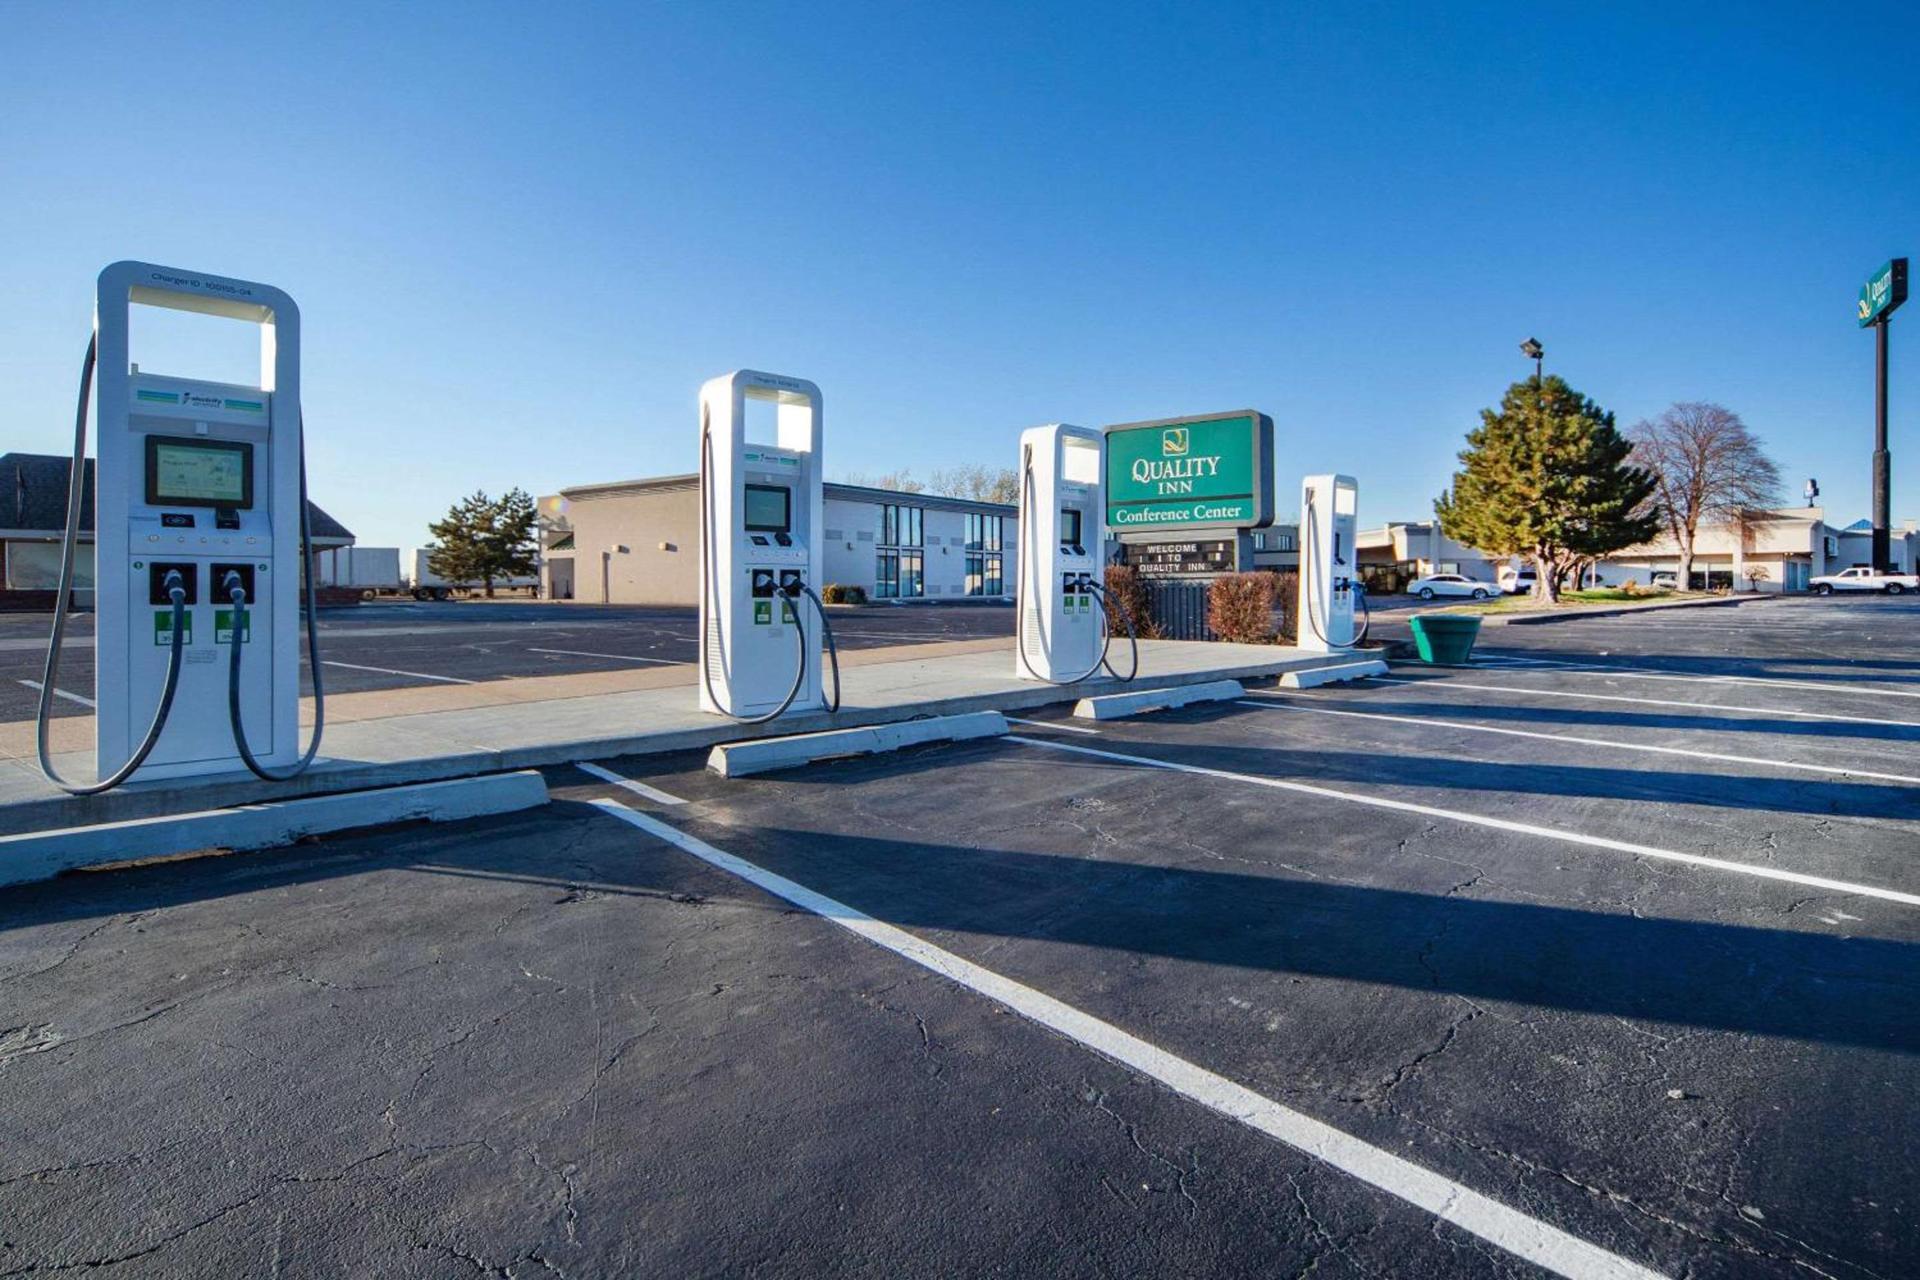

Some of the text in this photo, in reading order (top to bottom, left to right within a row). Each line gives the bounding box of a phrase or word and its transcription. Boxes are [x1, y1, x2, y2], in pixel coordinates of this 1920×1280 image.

[1132, 457, 1221, 483] QUALITY
[1158, 481, 1193, 495] INN
[1116, 505, 1242, 523] Conference Center
[1147, 543, 1198, 554] WELCOME
[1167, 553, 1182, 563] TO
[1139, 562, 1205, 573] QUALITY INN
